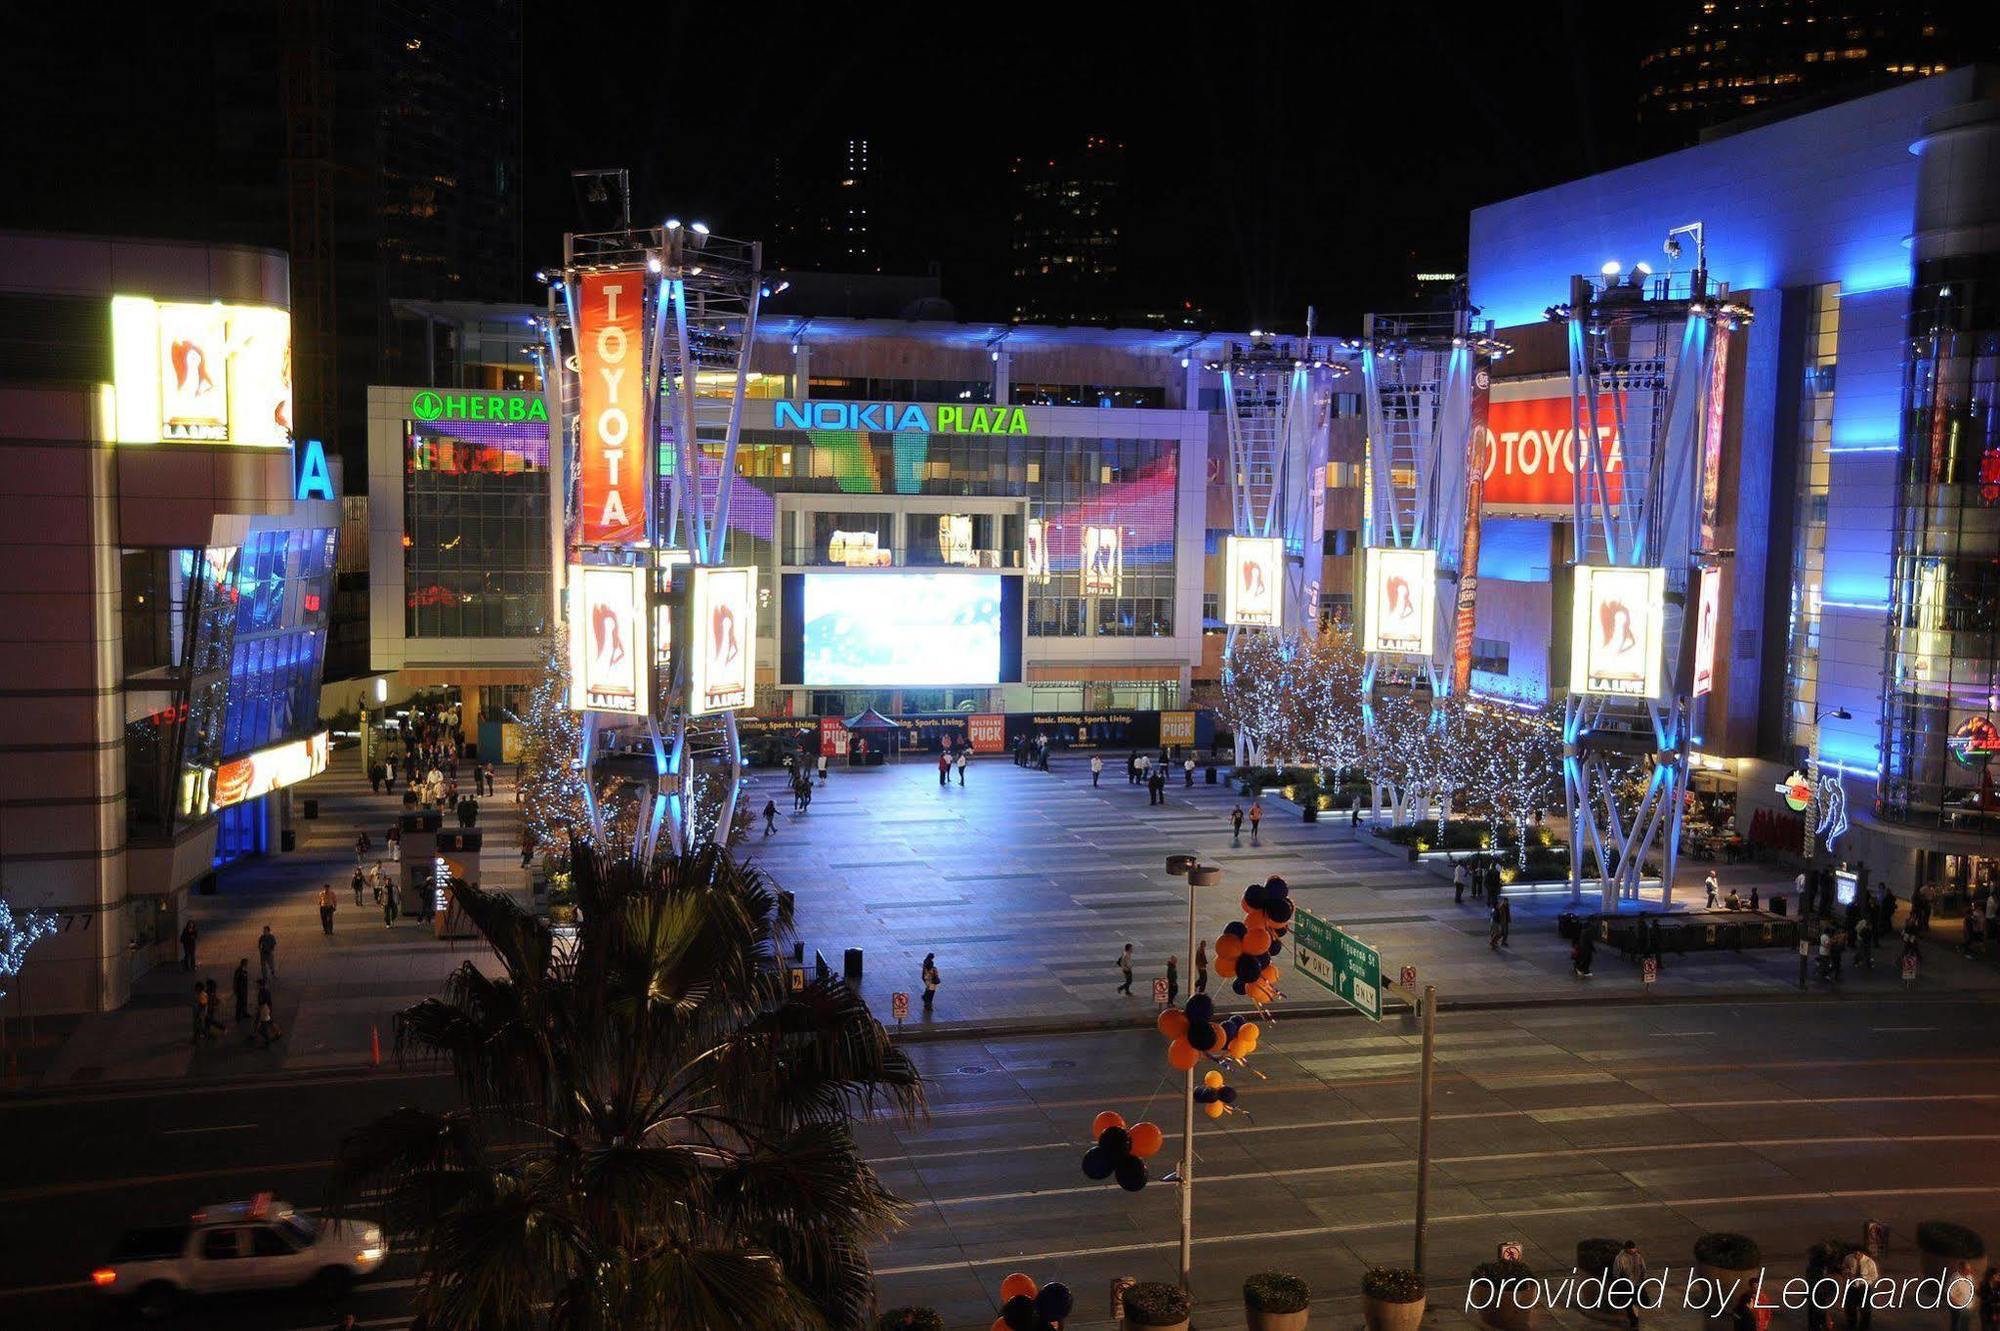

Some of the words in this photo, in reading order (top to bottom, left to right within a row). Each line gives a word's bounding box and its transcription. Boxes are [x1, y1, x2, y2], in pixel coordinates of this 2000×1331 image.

[446, 395, 549, 421] HERBA
[597, 285, 630, 527] TOYOTA
[774, 401, 931, 432] NOKIA
[937, 405, 1030, 435] PLAZA
[1500, 427, 1623, 475] TOYOTA
[290, 440, 335, 500] A
[769, 721, 794, 731] Sports.
[795, 721, 818, 730] Living.
[915, 719, 940, 729] Sports.
[941, 718, 965, 727] Living.
[1033, 716, 1055, 724] Music.
[1057, 716, 1081, 725] Dining.
[1084, 715, 1107, 725] Sports.
[1109, 714, 1133, 724] Living.
[970, 727, 1001, 741] PUCK
[1163, 723, 1192, 737] PUCK
[1312, 958, 1330, 977] ONLY
[1355, 984, 1375, 1005] ONLY
